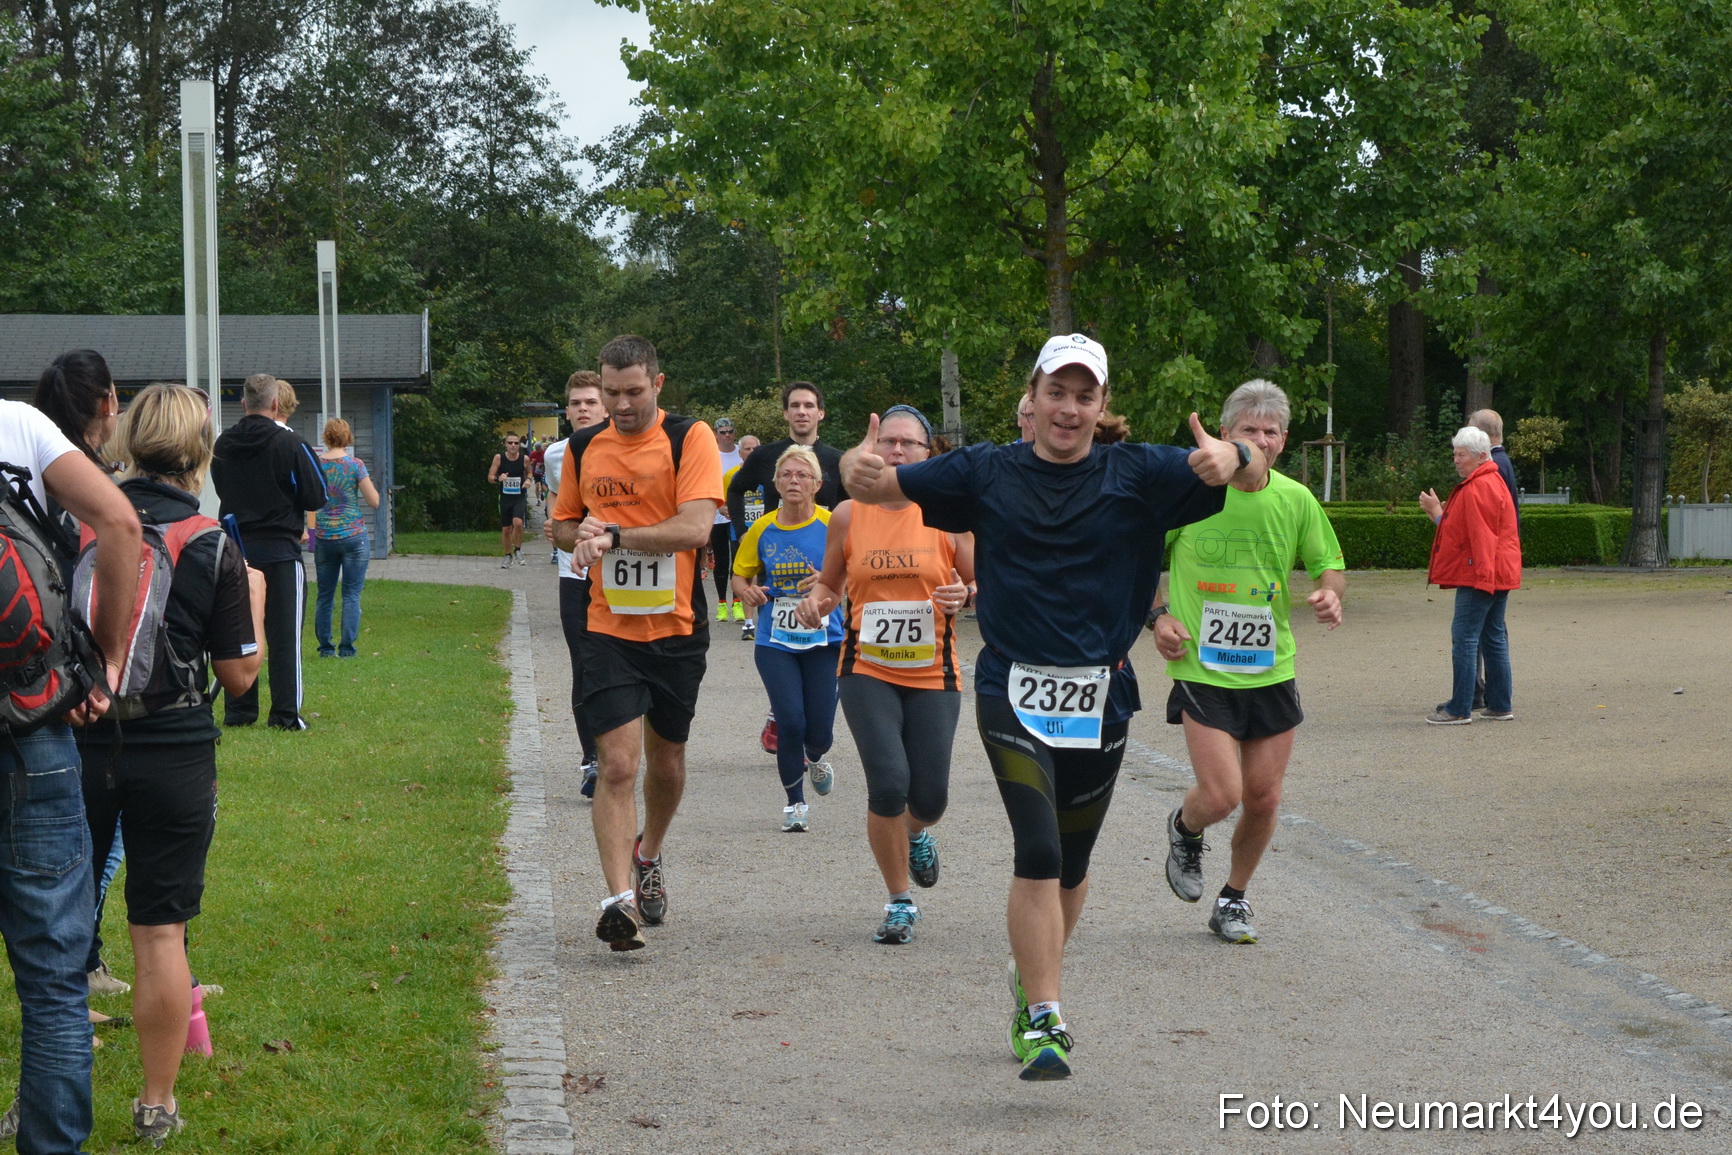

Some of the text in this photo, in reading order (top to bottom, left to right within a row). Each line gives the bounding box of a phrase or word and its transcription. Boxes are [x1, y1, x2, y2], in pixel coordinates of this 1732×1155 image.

[596, 482, 639, 497] OEXL
[870, 555, 920, 570] OEXL
[614, 559, 659, 586] 611
[1197, 581, 1237, 593] MERZ
[863, 607, 924, 616] PARTL Neumarkt
[1204, 607, 1267, 620] PARTL Neumarkt
[875, 618, 922, 644] 275
[1208, 619, 1272, 647] 2423
[880, 649, 916, 659] Monika
[1217, 651, 1257, 664] Michael
[1018, 676, 1098, 712] 2328
[1046, 721, 1064, 734] Uli
